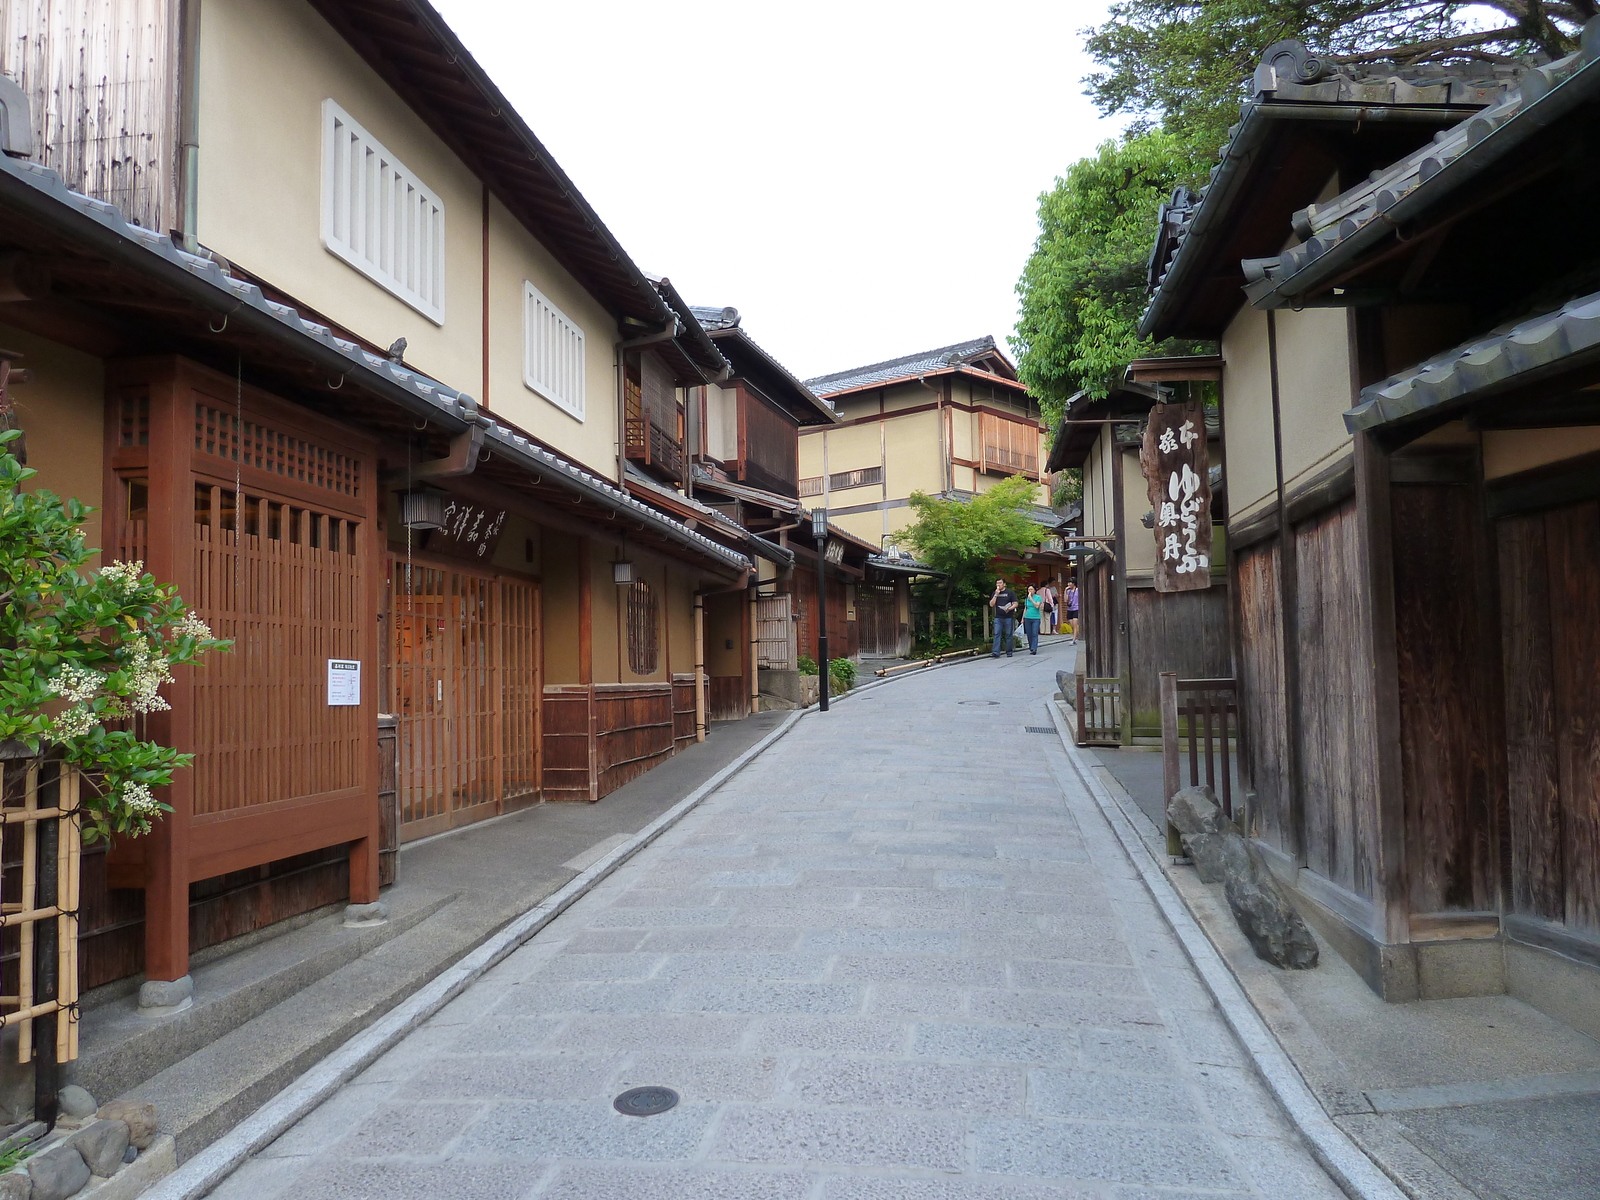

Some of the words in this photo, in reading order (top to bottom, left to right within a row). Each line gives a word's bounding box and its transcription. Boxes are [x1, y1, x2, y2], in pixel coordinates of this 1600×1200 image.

[1158, 501, 1182, 561] 奥丹
[1168, 463, 1209, 574] ゆどうふ
